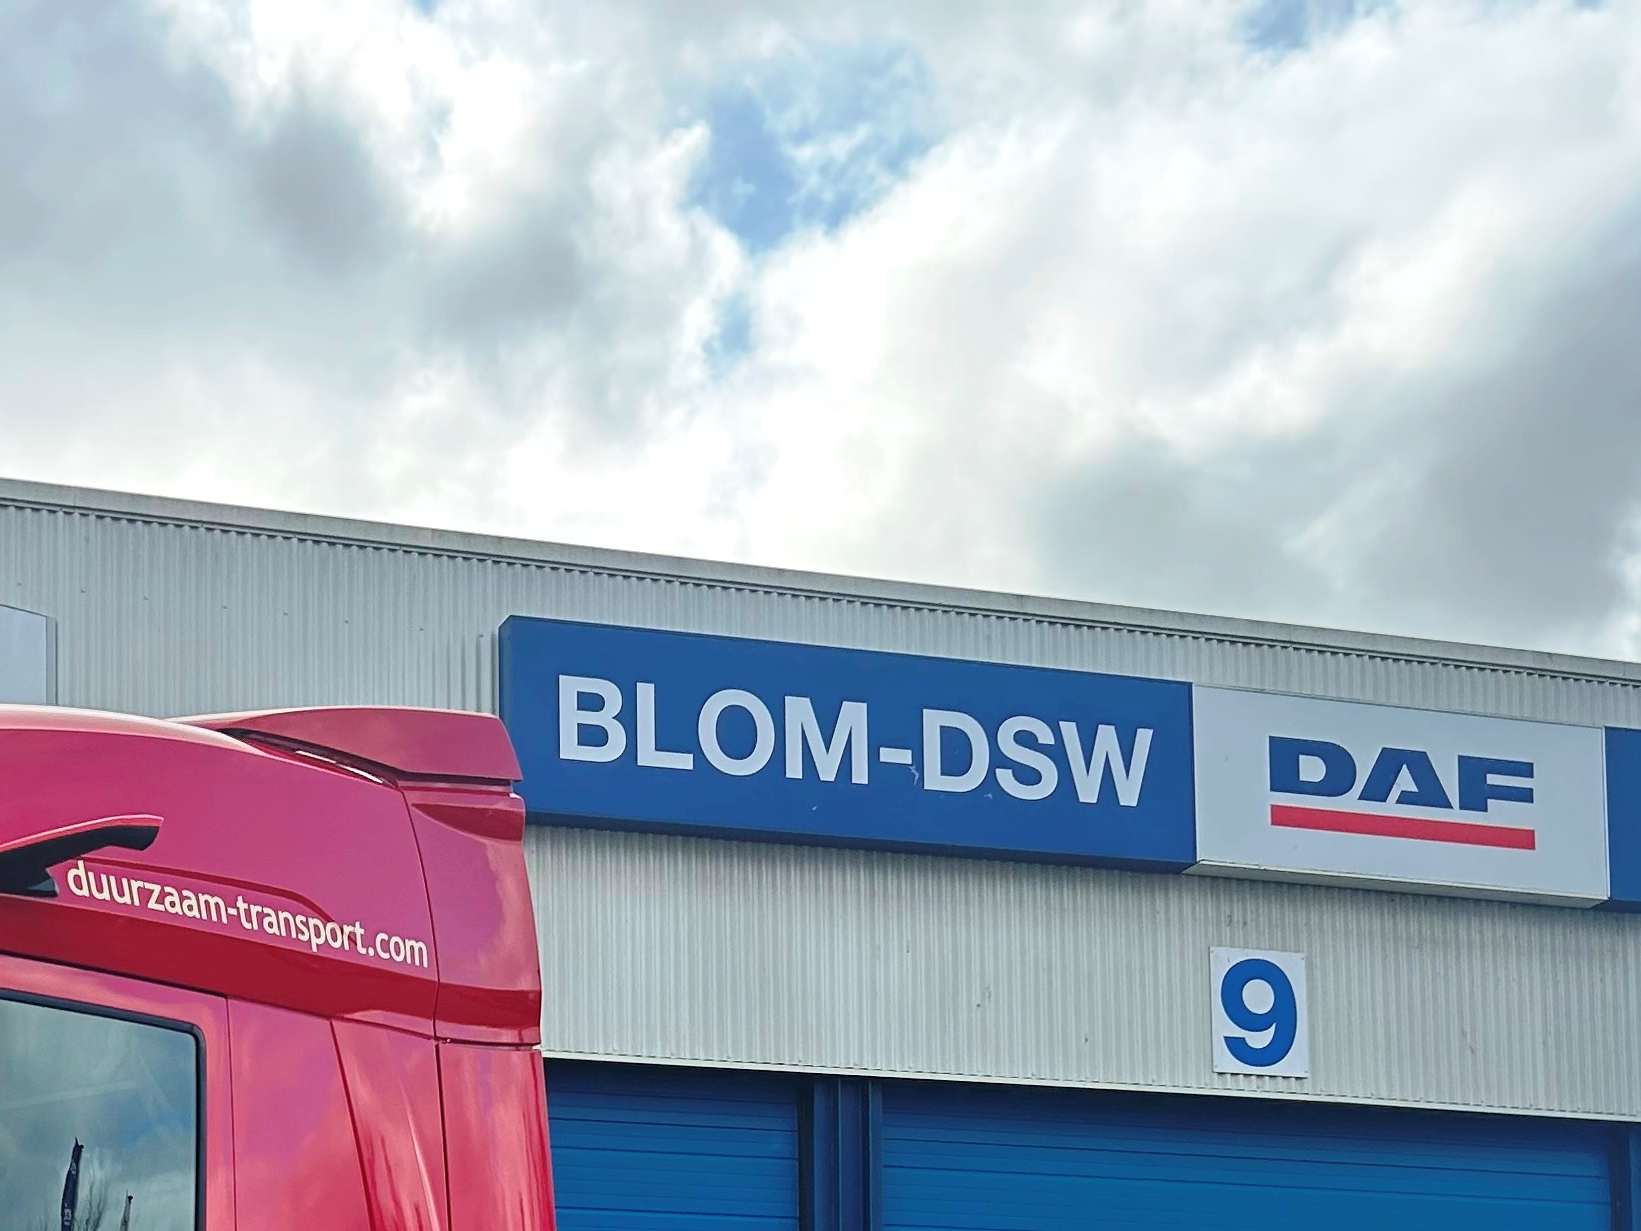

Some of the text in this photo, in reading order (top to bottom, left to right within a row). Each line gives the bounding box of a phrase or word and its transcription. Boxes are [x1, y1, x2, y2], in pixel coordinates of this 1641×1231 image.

[558, 674, 1153, 807] BLOM-DSW
[1269, 735, 1535, 812] DAF
[67, 860, 428, 968] duurzaam-transport.com
[1220, 958, 1298, 1067] 9
